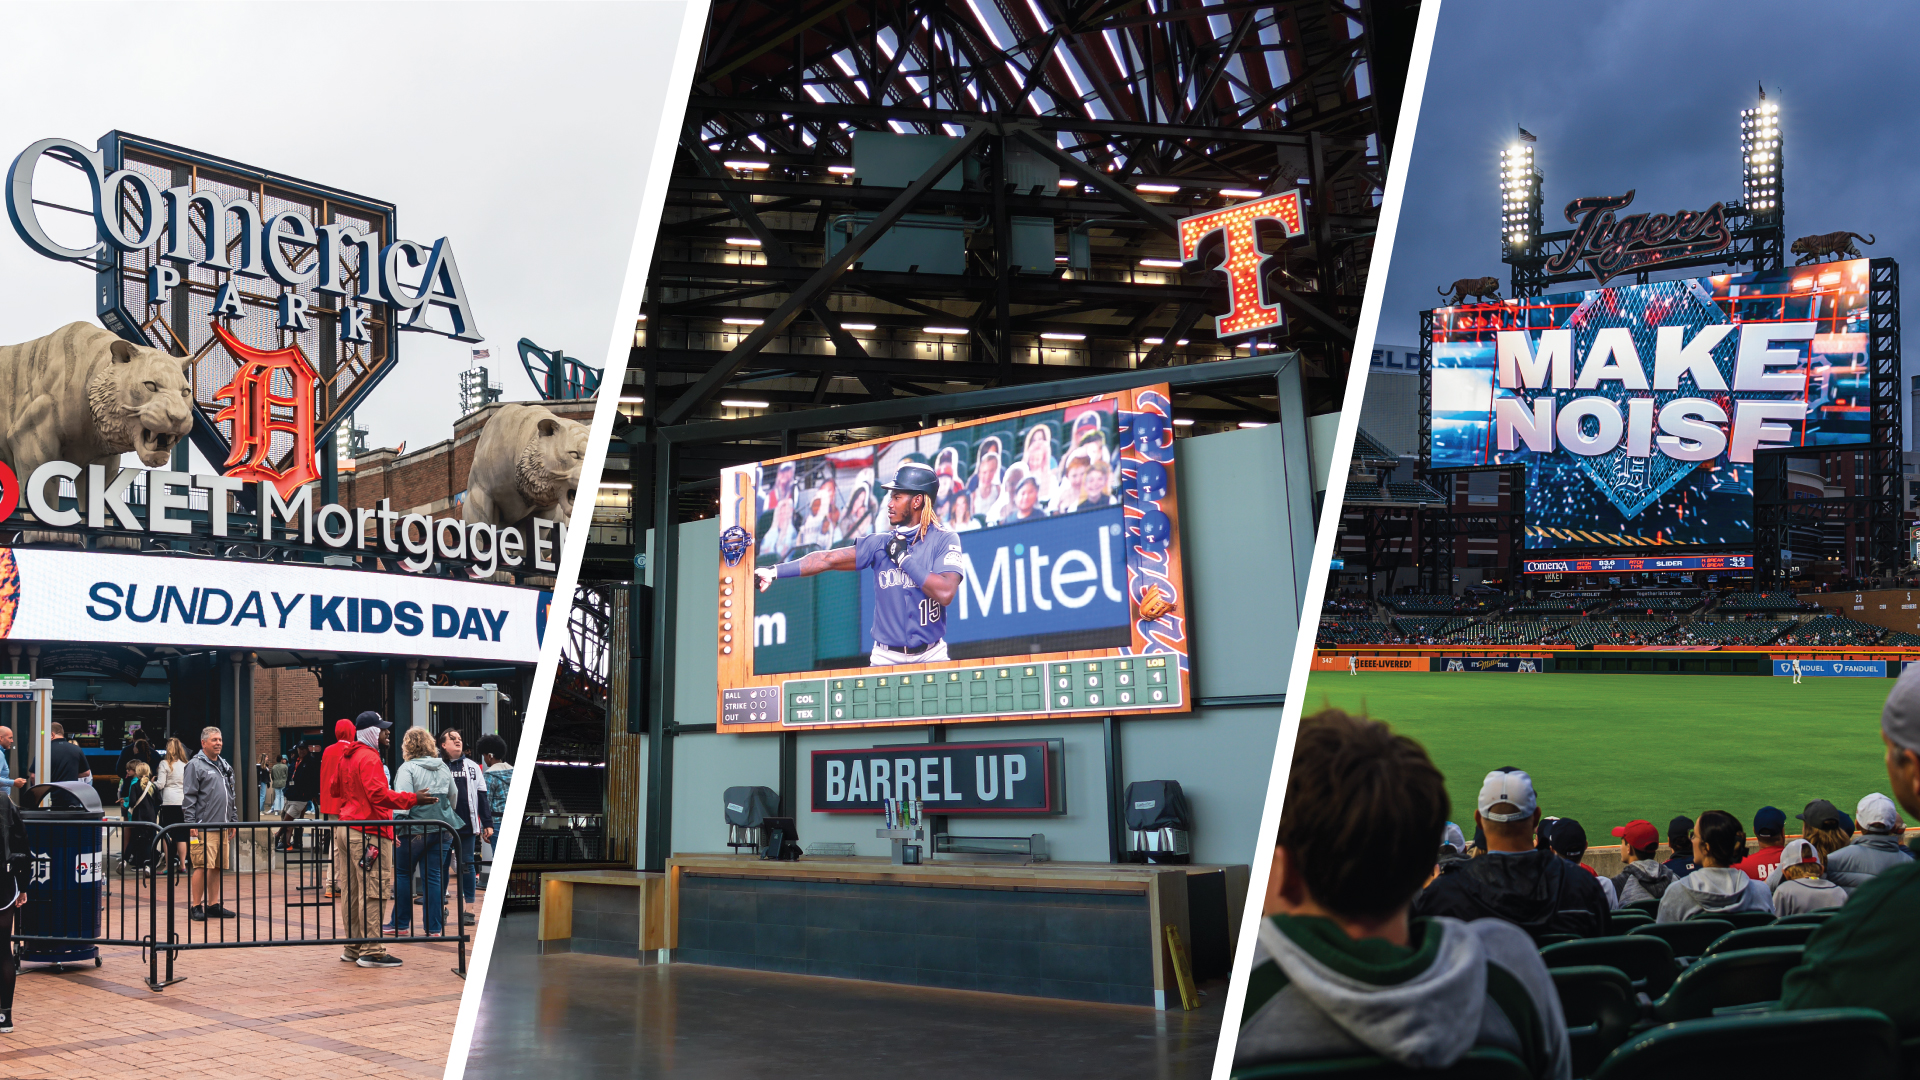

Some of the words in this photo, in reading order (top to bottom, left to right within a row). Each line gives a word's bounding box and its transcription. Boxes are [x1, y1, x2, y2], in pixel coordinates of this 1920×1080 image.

[1545, 189, 1732, 286] Tigers
[1177, 188, 1306, 340] T
[1497, 321, 1818, 391] MAKE
[257, 480, 524, 578] Mortgage
[86, 581, 305, 629] SUNDAY
[310, 593, 424, 637] KIDS
[432, 603, 509, 643] DAY
[919, 597, 941, 626] 15
[1059, 665, 1066, 673] R
[1089, 663, 1096, 671] H
[1121, 661, 1127, 669] E
[1147, 658, 1165, 667] LOB
[725, 702, 747, 710] STRIKE
[796, 695, 813, 704] COL
[835, 693, 842, 702] 0
[1059, 678, 1068, 688] 0
[1089, 676, 1097, 686] 0
[1120, 674, 1128, 684] 0
[1153, 672, 1161, 682] 1
[796, 709, 813, 718] TEX
[835, 709, 842, 718] 0
[1060, 696, 1069, 706] 0
[1090, 694, 1098, 704] 0
[1121, 692, 1130, 702] 0
[1153, 690, 1162, 701] 0
[725, 713, 739, 721] OUT
[826, 756, 962, 802] BARREL
[976, 753, 1027, 801] UP
